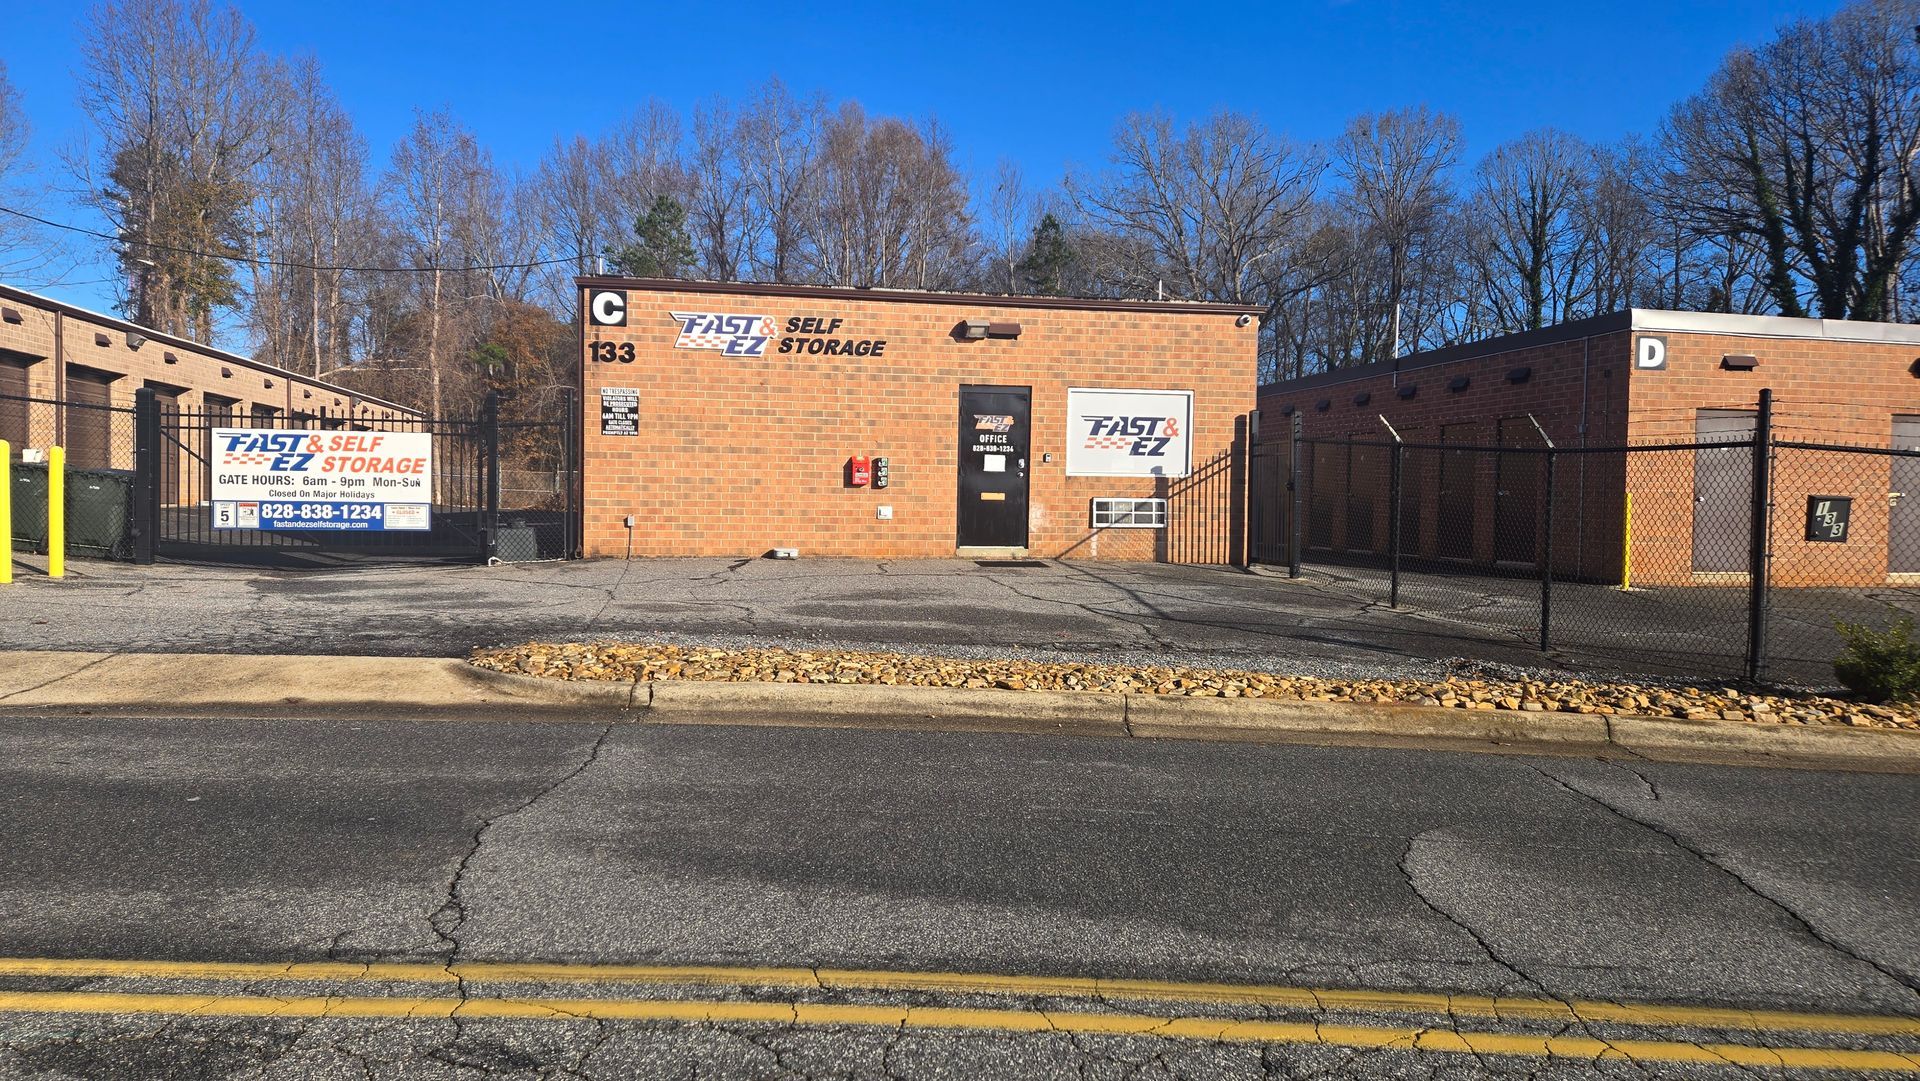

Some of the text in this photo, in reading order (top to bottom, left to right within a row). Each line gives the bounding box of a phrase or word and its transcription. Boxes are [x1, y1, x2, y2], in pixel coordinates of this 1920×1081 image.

[592, 291, 624, 325] C
[674, 313, 762, 334] FAST
[785, 317, 843, 334] SELF
[588, 341, 636, 363] 133
[725, 335, 768, 355] EZ
[778, 337, 887, 357] STORAGE
[1639, 337, 1665, 368] D
[1081, 416, 1166, 436] FAST
[217, 433, 309, 452] FAST
[328, 435, 384, 452] SELF
[980, 434, 1007, 443] OFFICE
[1129, 437, 1171, 456] EZ
[270, 453, 427, 474] EZ STORAGE
[219, 474, 248, 485] GATE
[252, 475, 295, 486] HOURS:
[302, 476, 327, 486] 6am
[340, 477, 365, 488] 9pm
[269, 489, 375, 500] Closed On Major Holidays
[220, 510, 230, 522] 5
[261, 503, 383, 520] 828-838-1234
[273, 520, 369, 530] fastandezselfstorage.com
